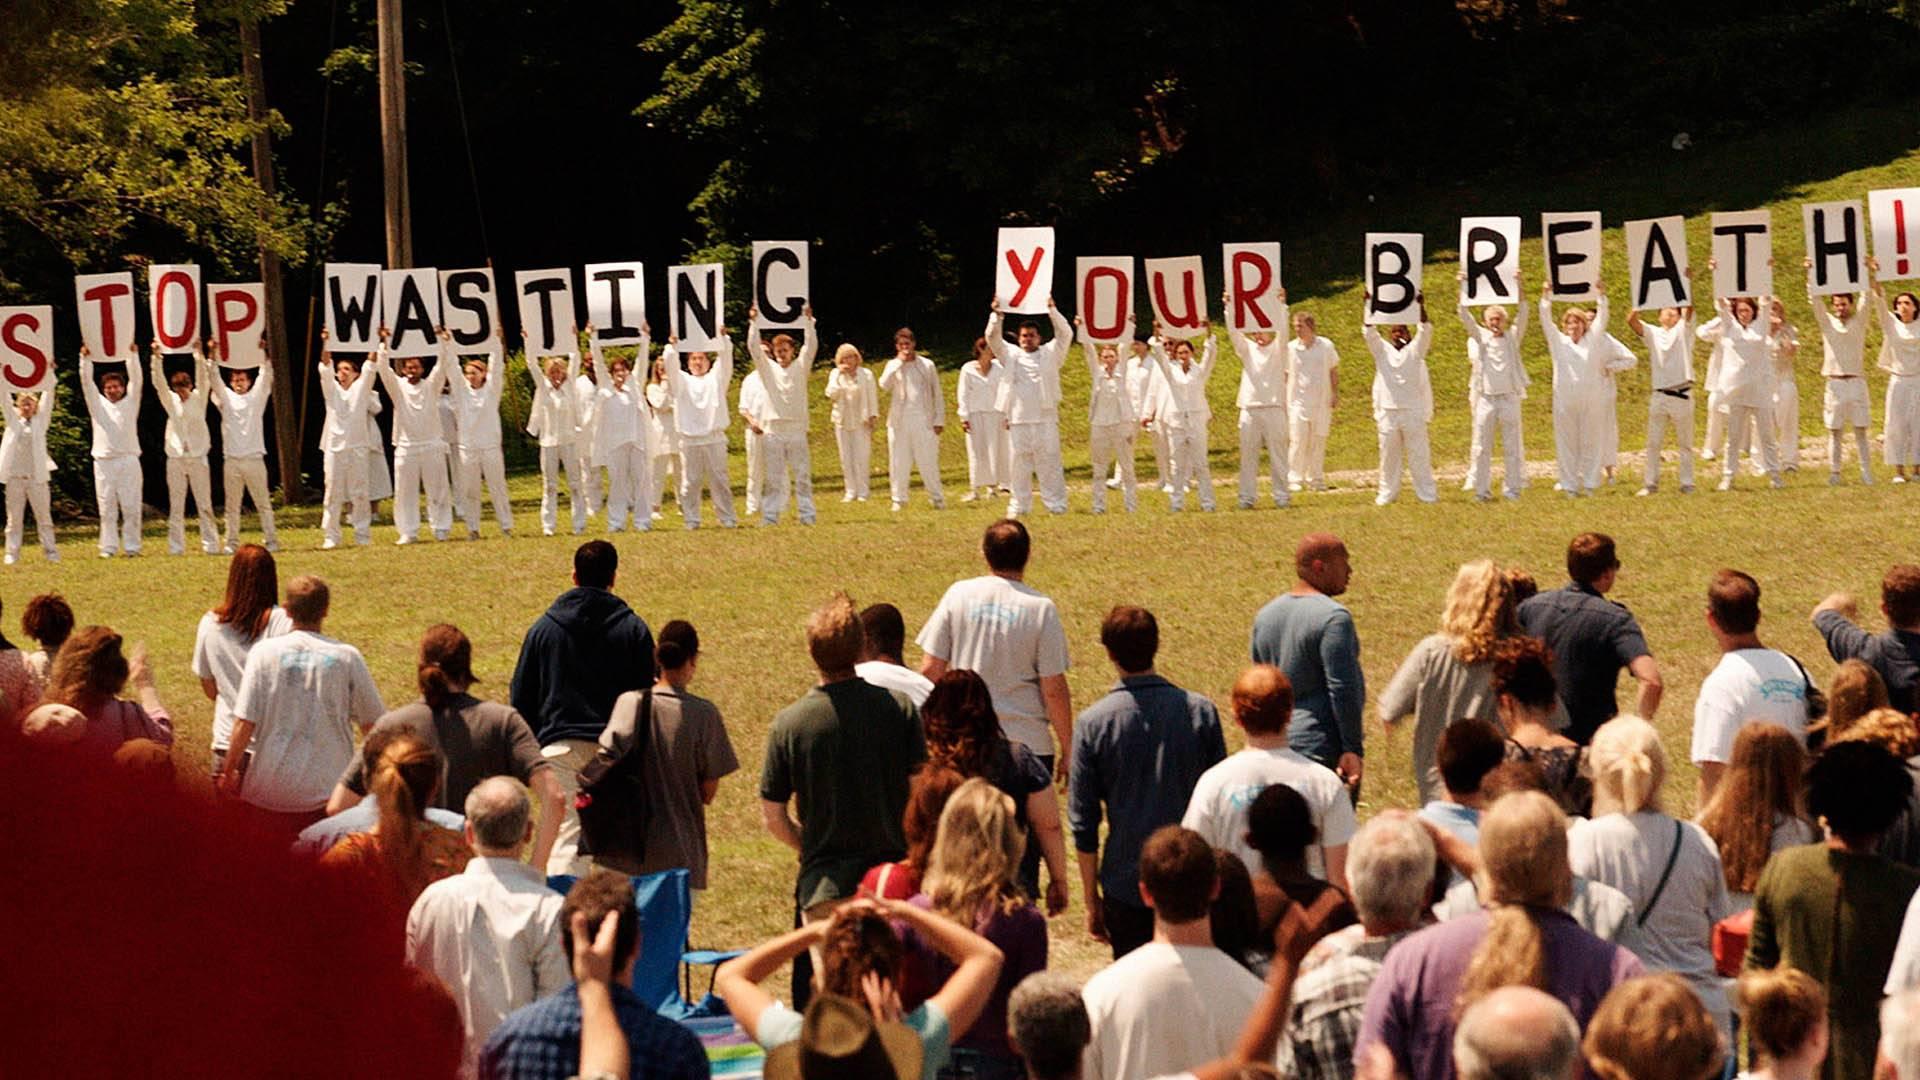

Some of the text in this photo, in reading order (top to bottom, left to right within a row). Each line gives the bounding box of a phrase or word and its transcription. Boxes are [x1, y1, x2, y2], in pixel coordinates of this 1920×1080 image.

[2, 200, 1910, 388] STOP WASTING YOUR BREATH!
